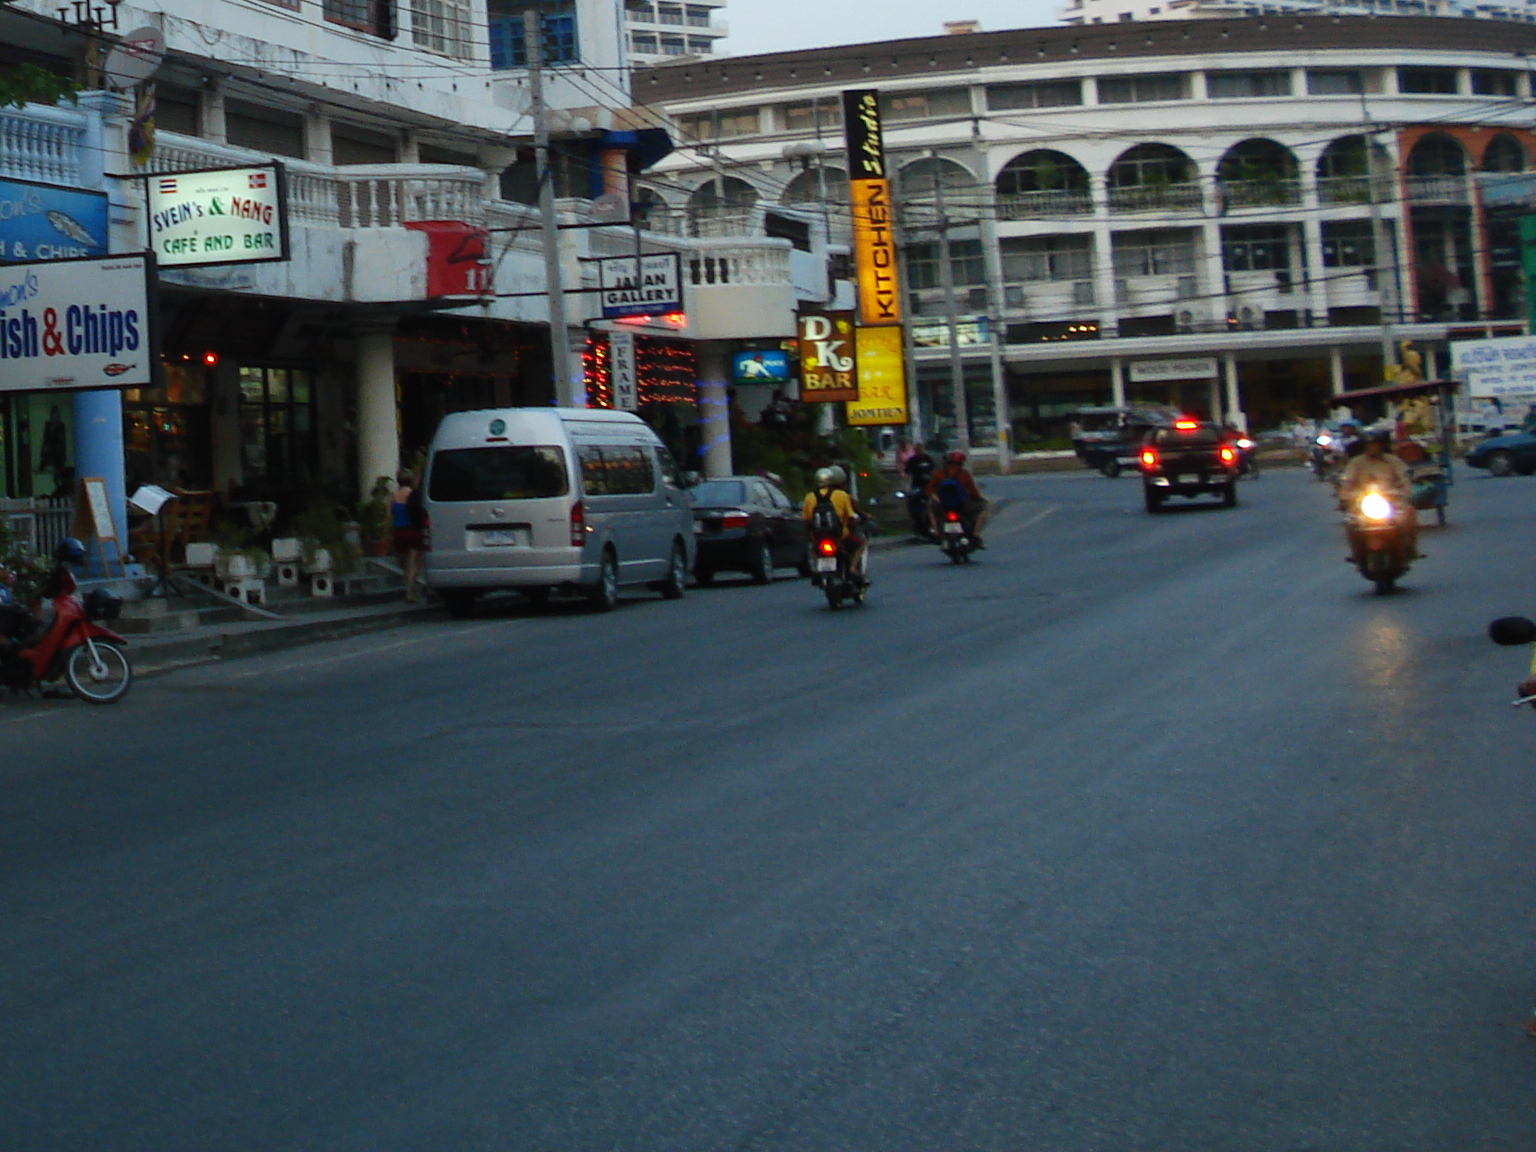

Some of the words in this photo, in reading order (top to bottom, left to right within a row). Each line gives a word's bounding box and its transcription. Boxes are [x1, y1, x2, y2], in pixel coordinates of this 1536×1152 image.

[859, 94, 883, 175] Studio
[209, 196, 225, 216] &
[230, 196, 273, 226] NANG
[14, 241, 28, 258] &
[204, 234, 233, 252] AND
[243, 232, 274, 250] BAR
[867, 184, 895, 320] KITCHEN
[607, 288, 675, 304] GALLERY
[42, 307, 65, 357] &
[66, 304, 139, 357] Chips
[616, 347, 632, 409] FRAME
[804, 372, 852, 389] BAR
